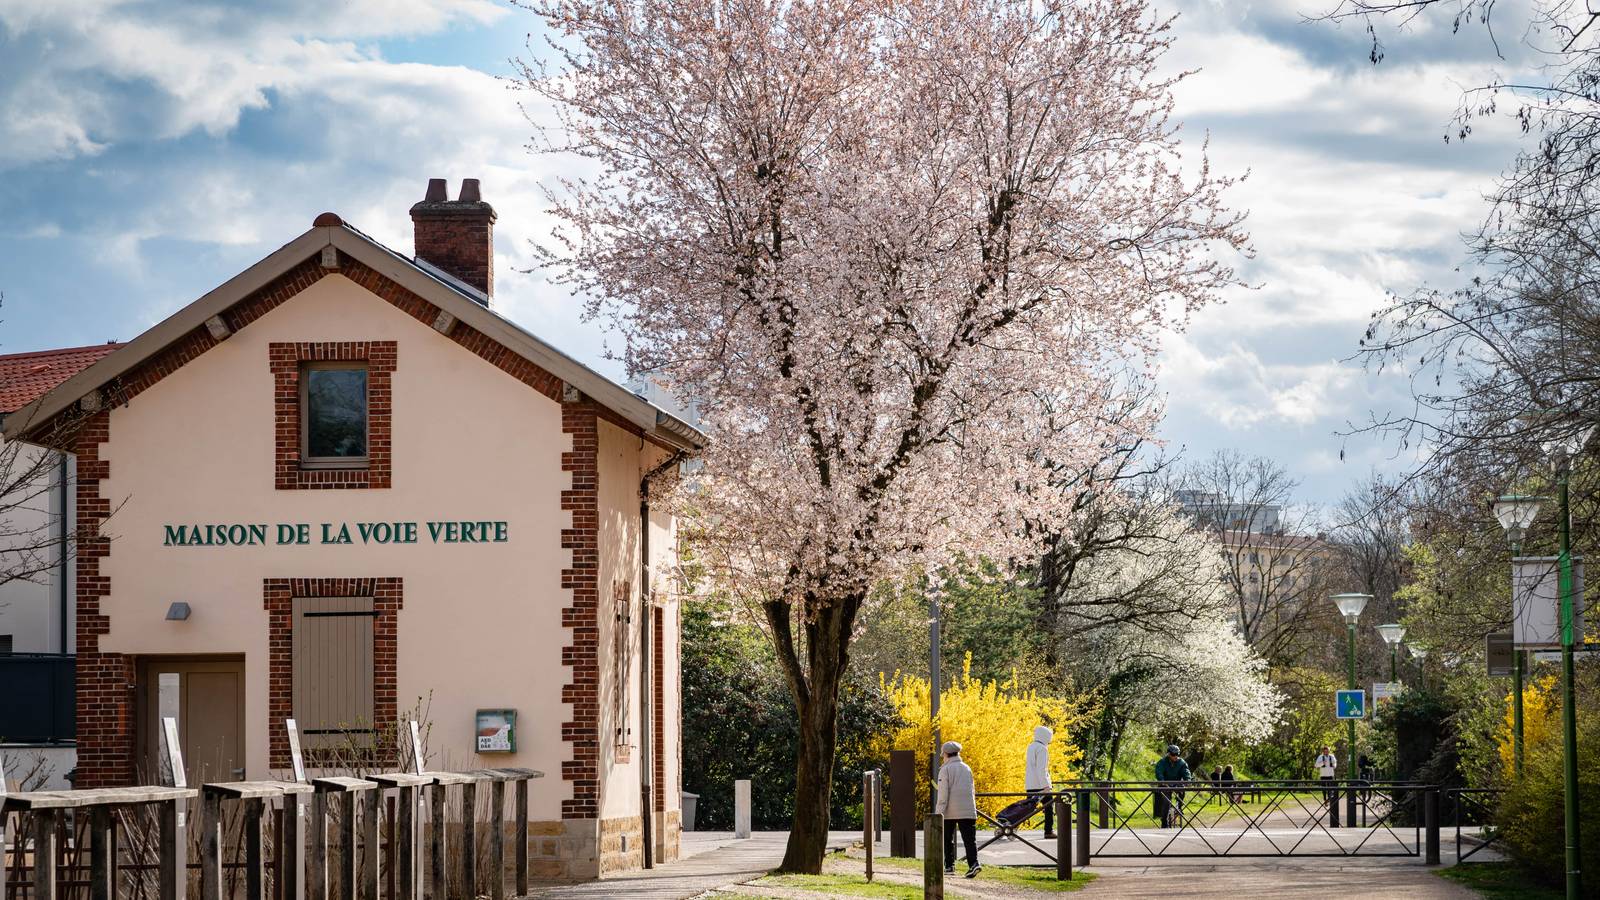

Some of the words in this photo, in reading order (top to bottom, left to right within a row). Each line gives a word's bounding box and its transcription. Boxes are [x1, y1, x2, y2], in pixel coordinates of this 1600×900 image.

[163, 524, 268, 547] MAISON
[276, 523, 310, 546] DE
[320, 523, 352, 545] LA
[357, 522, 418, 544] VOIE
[426, 521, 508, 543] VERTE
